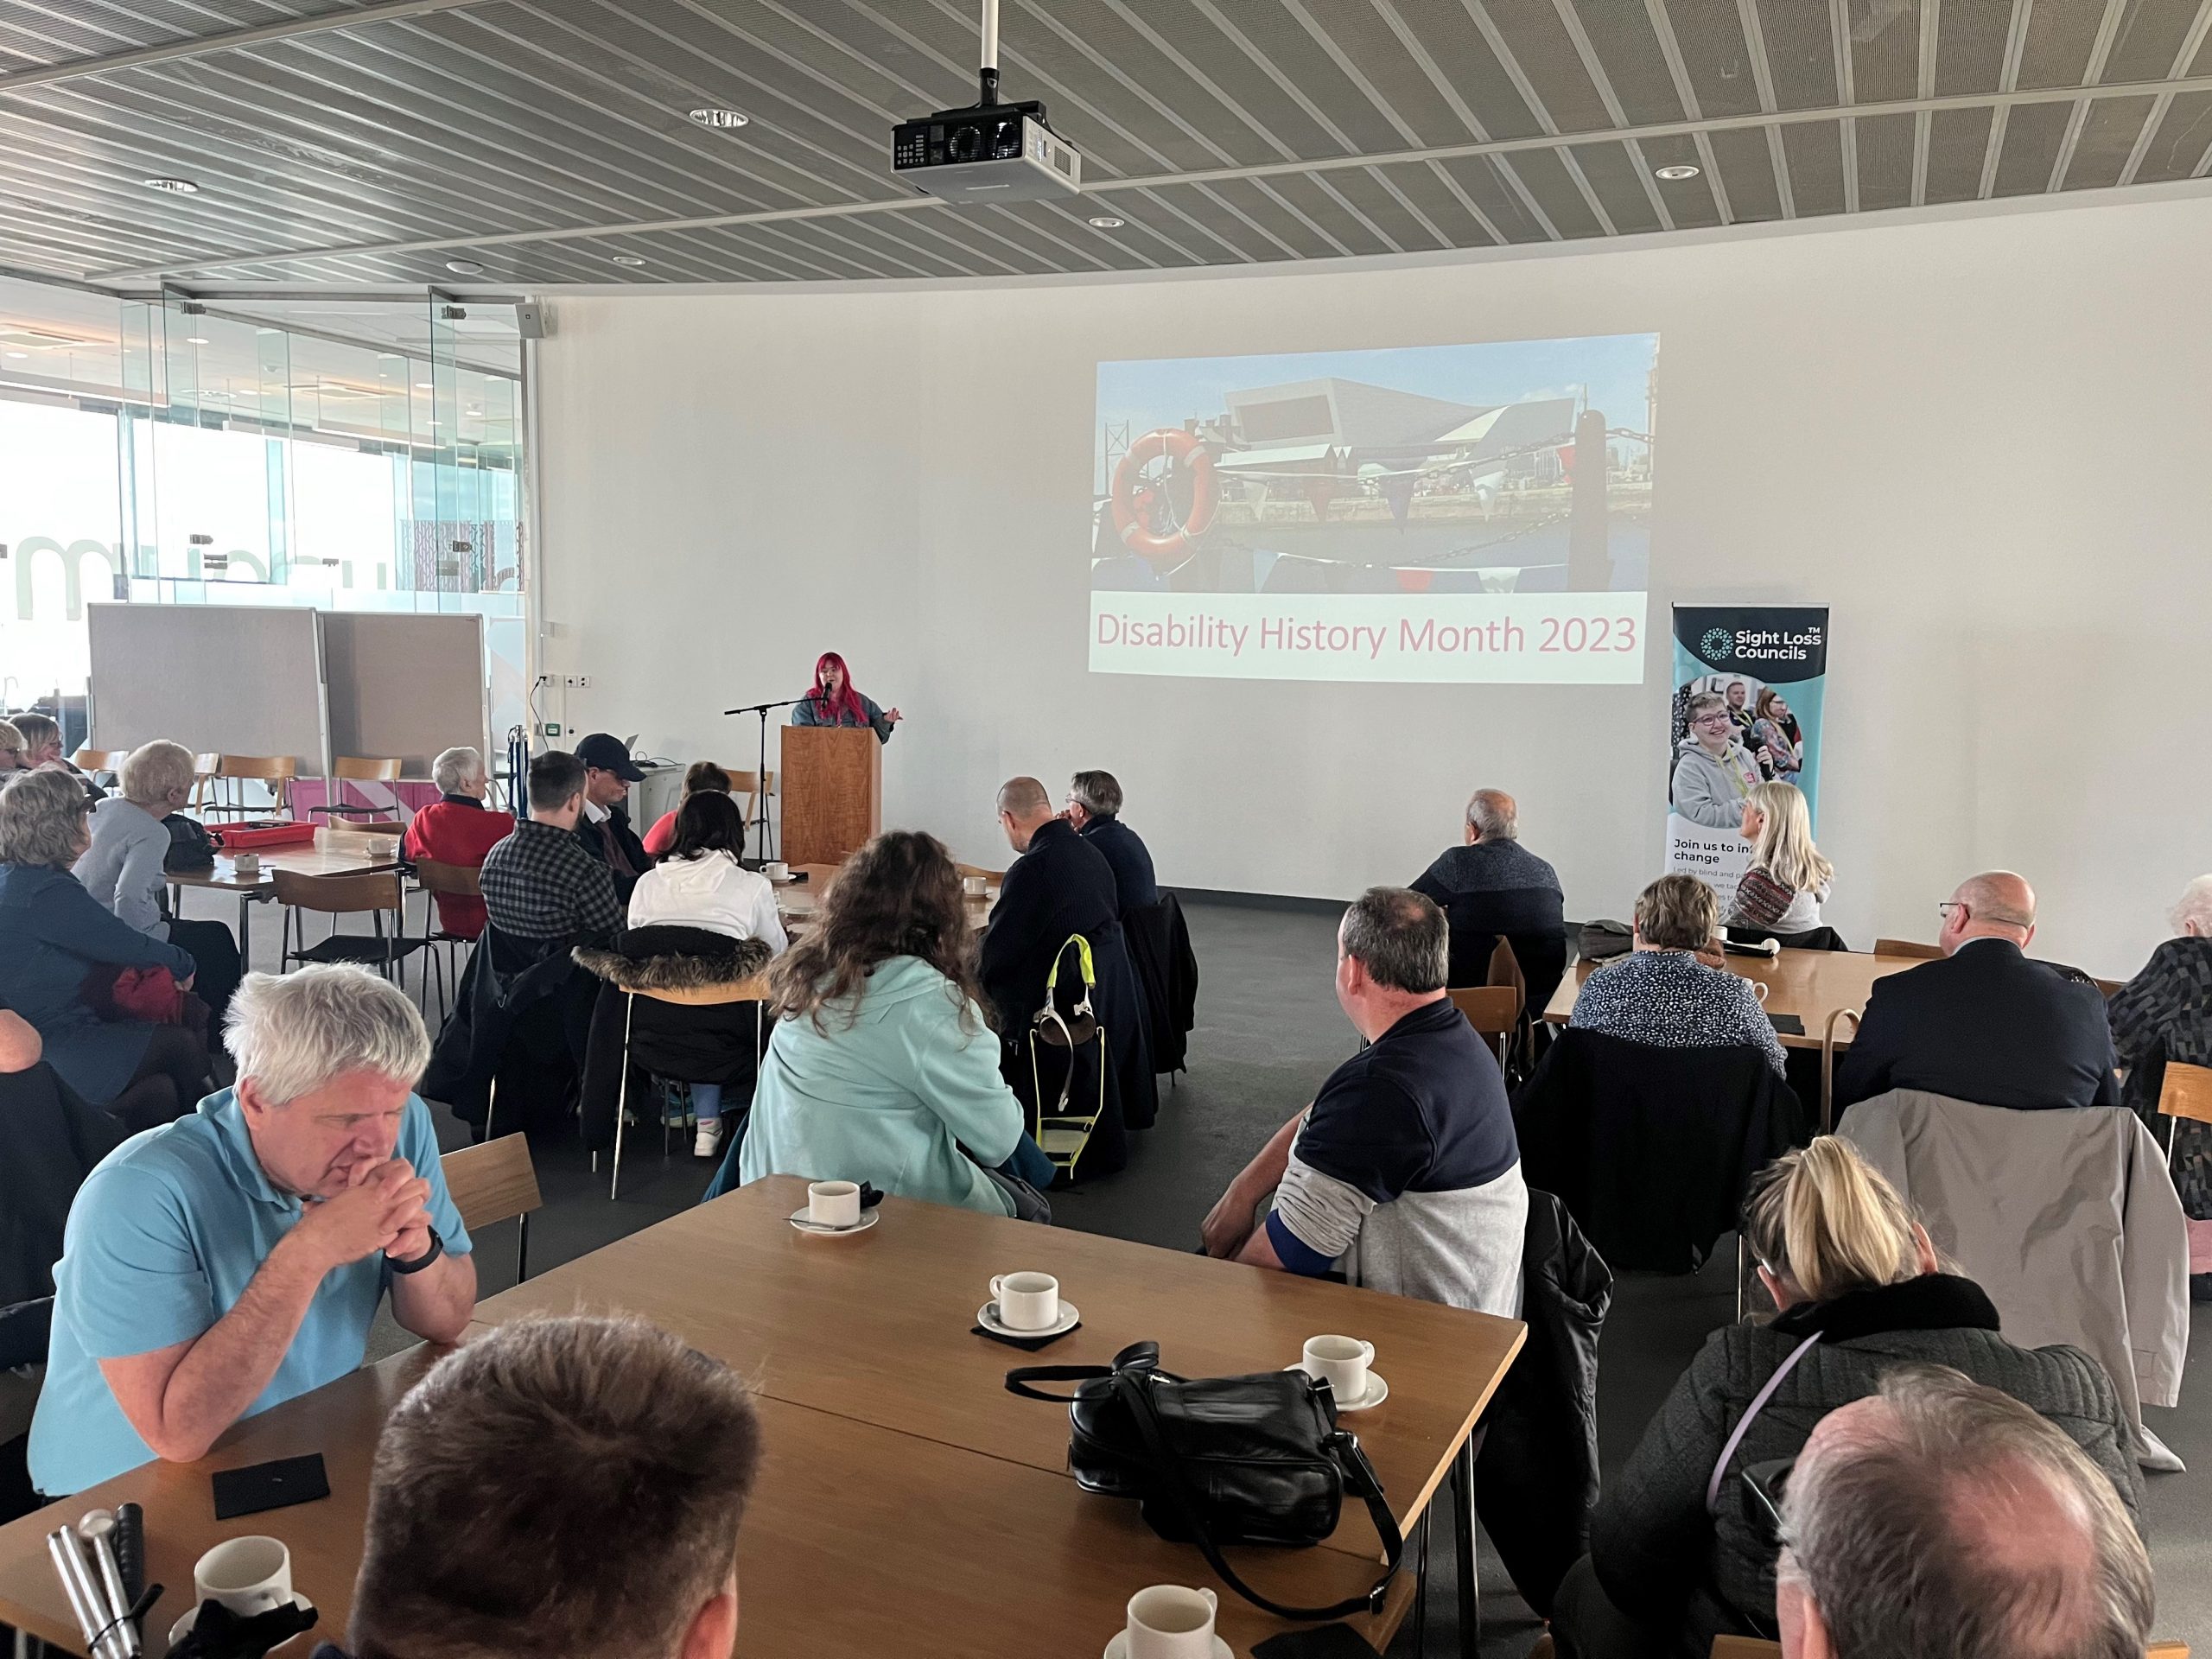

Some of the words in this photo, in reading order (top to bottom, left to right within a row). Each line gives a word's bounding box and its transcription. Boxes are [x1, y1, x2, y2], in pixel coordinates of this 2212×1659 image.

[1096, 612, 1249, 657] Disability
[1259, 615, 1386, 660] History
[1398, 617, 1526, 654] Month
[1538, 616, 1637, 653] 2023
[1735, 630, 1780, 647] Sight
[1783, 632, 1821, 645] Loss
[1734, 645, 1807, 660] Councils
[1675, 839, 1700, 849] Join
[1721, 843, 1734, 853] to
[1675, 851, 1719, 864] change
